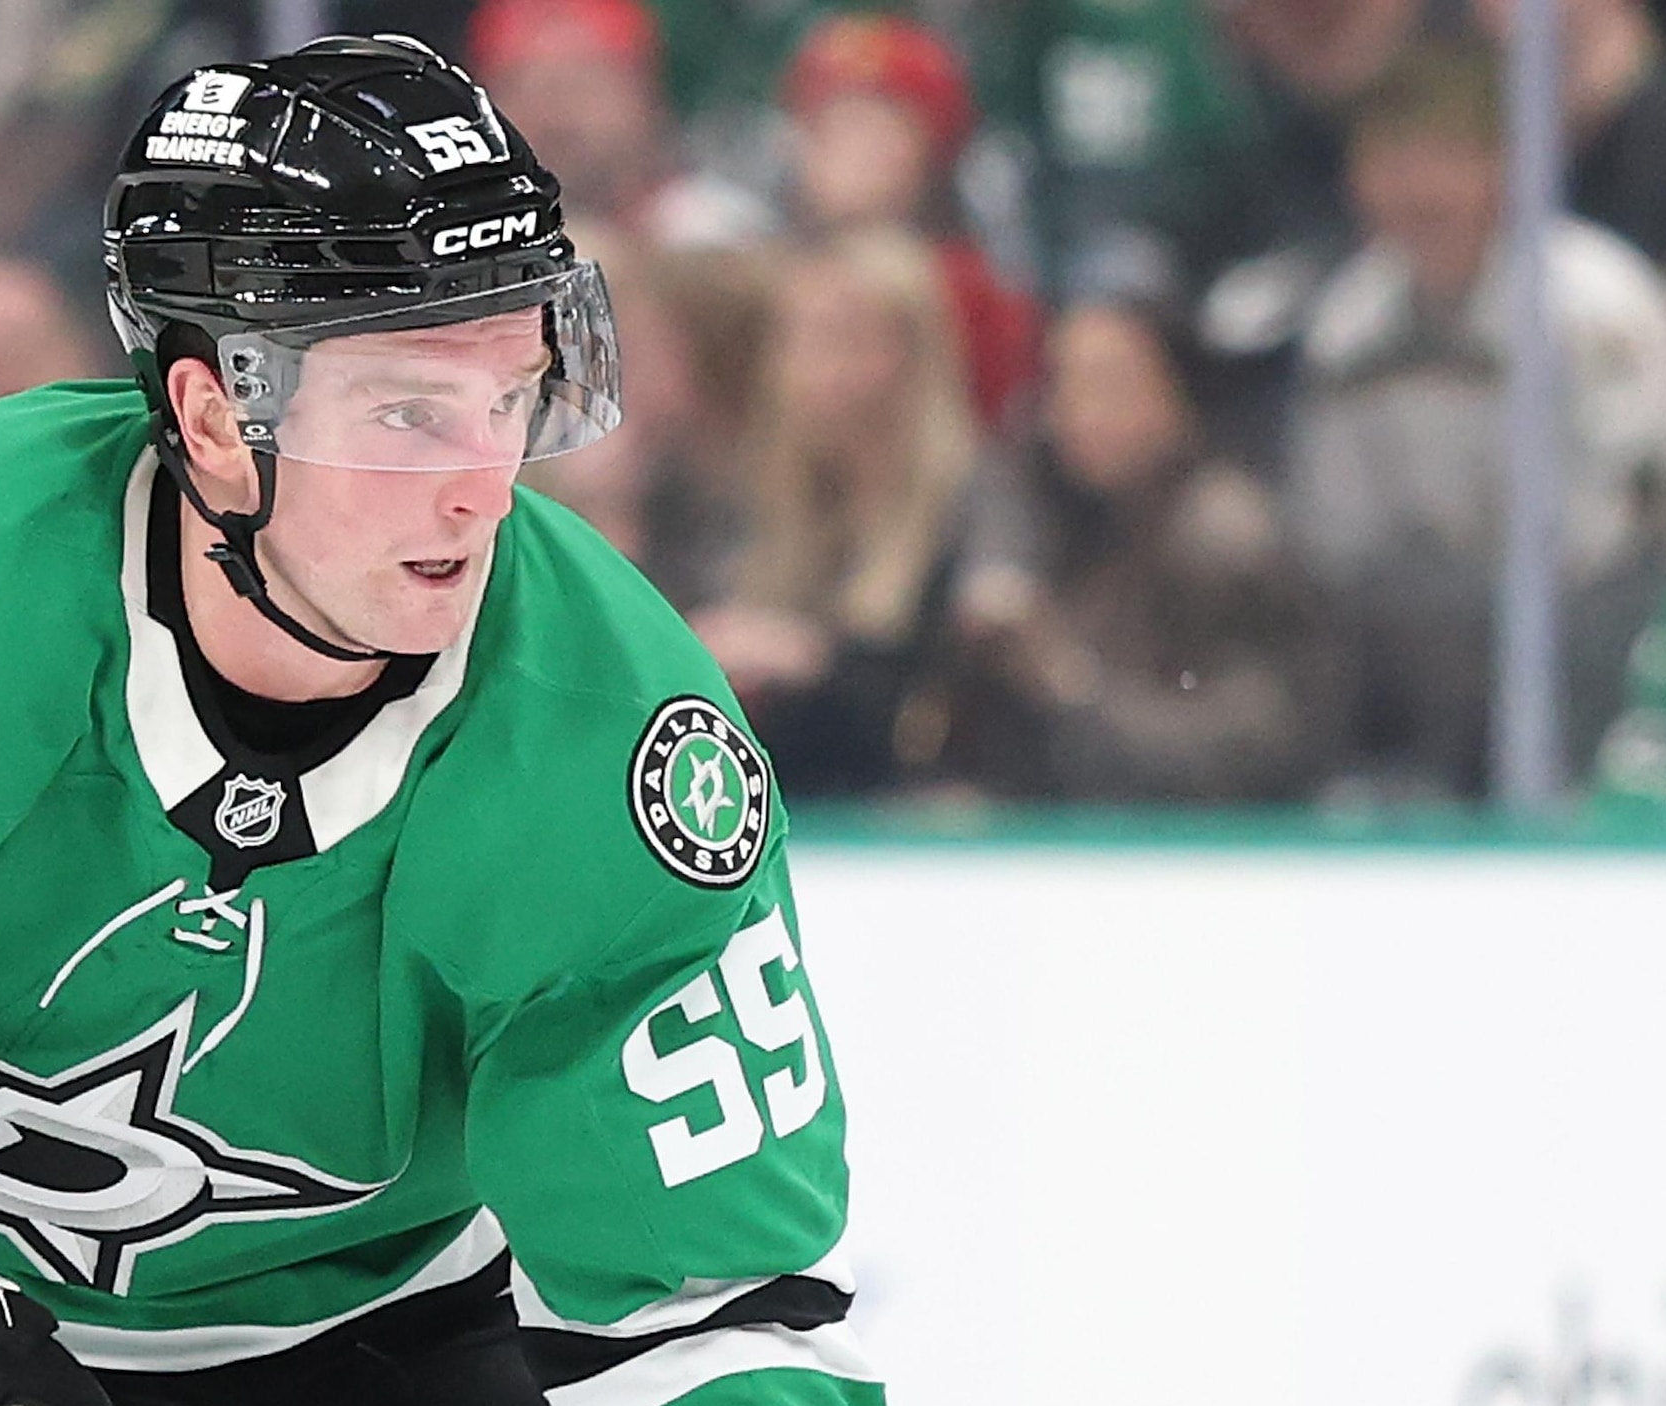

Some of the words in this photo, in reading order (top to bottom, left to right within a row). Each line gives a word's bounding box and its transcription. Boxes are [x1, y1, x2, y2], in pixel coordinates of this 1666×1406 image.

[159, 110, 248, 139] ENERGY
[405, 116, 492, 173] 55
[145, 136, 245, 167] TRANSFER
[433, 211, 537, 256] CCM
[229, 799, 271, 829] NHL
[645, 712, 729, 830] DALLAS
[694, 774, 763, 871] STARS
[620, 903, 828, 1189] 55
